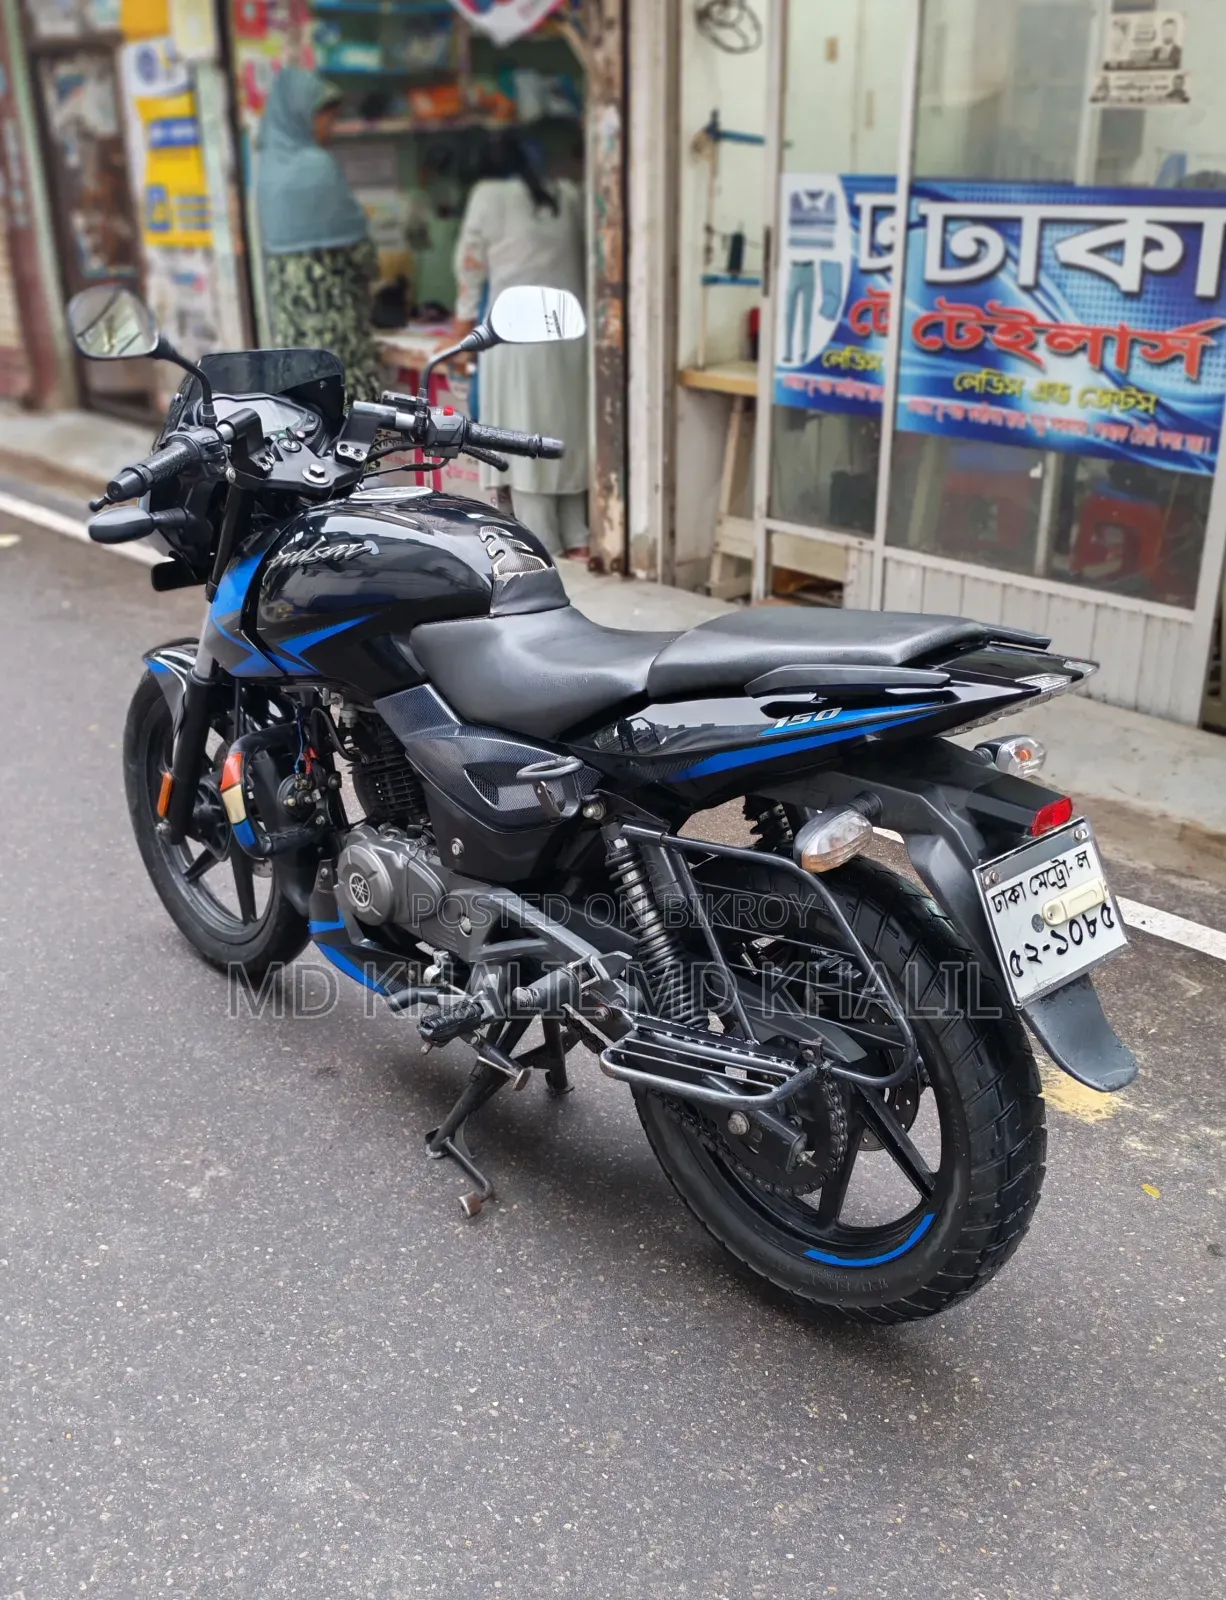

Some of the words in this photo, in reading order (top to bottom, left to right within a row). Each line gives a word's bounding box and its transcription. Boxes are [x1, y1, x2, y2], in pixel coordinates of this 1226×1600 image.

[919, 200, 1226, 298] ঢাকা
[911, 296, 1226, 381] টেইলার্স
[953, 367, 1023, 398] লেডিস
[773, 706, 843, 729] 150
[990, 881, 1027, 914] ঢাকা
[1009, 902, 1115, 978] ৫২-১০৮৫
